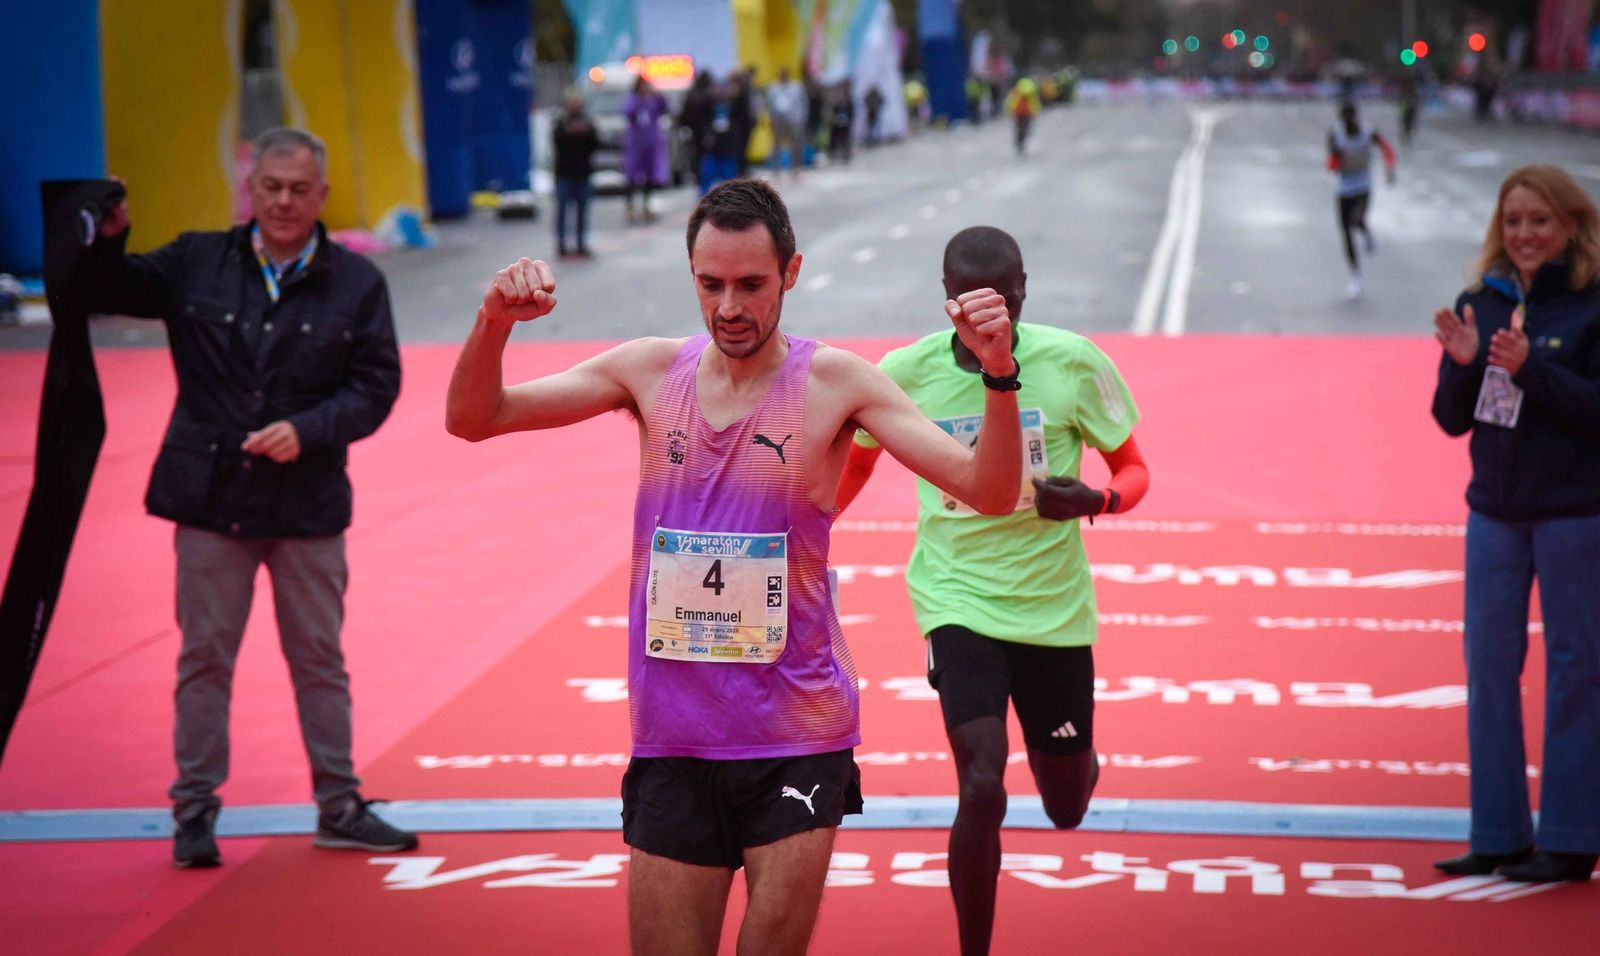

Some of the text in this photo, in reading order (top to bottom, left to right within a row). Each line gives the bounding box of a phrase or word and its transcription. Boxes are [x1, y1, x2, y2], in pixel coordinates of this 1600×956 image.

[691, 536, 741, 546] maratón
[701, 544, 741, 555] sevilla
[702, 559, 725, 596] 4
[675, 607, 742, 623] Emmanuel
[688, 646, 709, 655] HOKA
